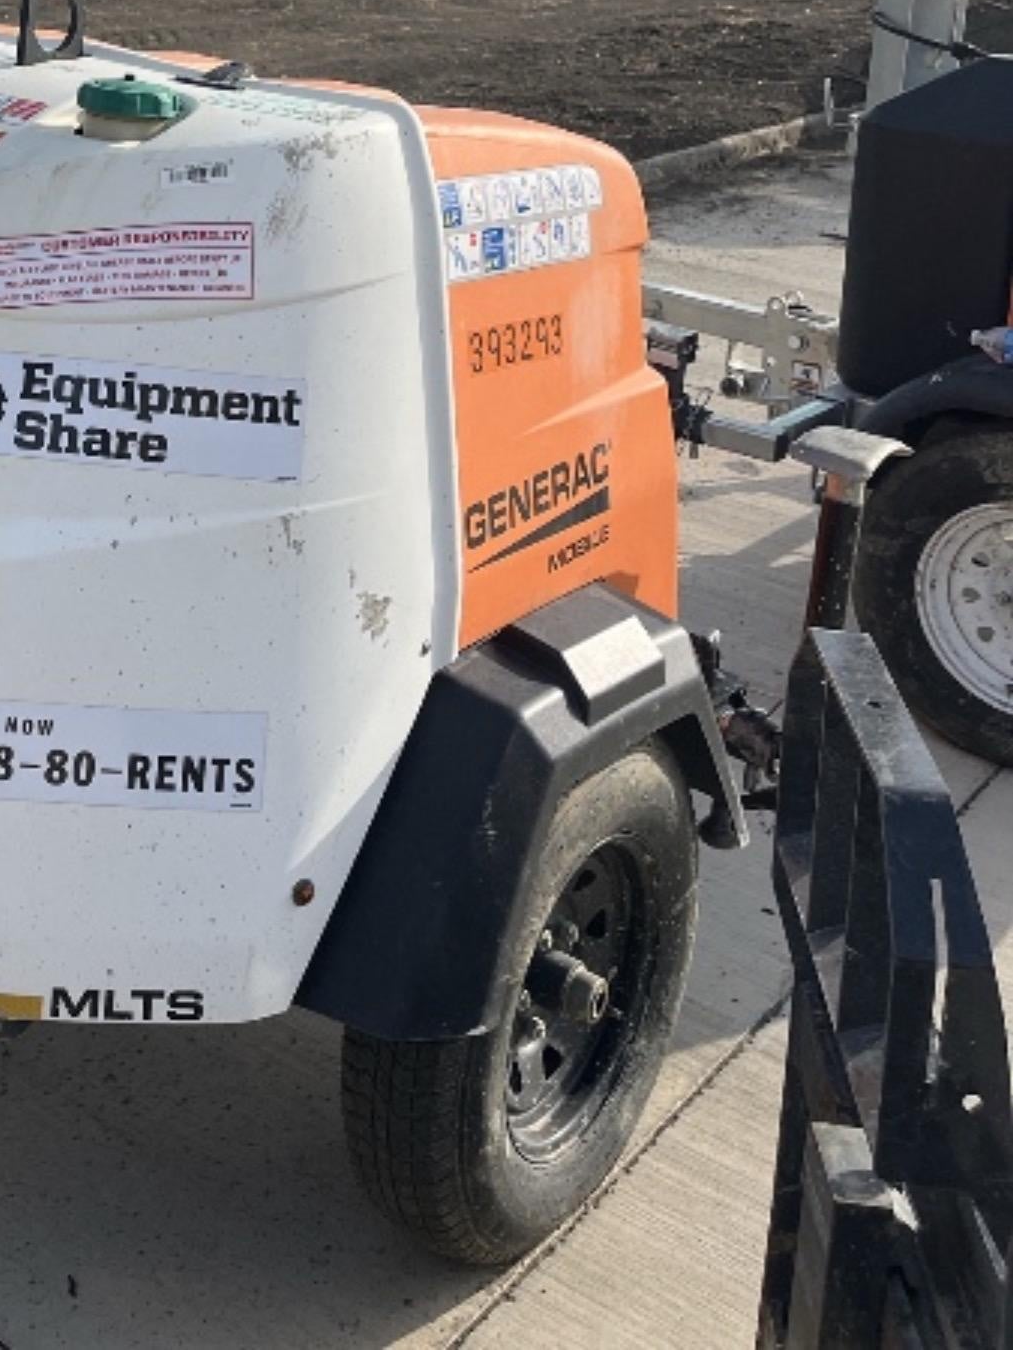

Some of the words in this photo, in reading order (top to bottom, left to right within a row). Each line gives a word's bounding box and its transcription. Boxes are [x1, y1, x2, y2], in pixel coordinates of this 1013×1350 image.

[469, 314, 563, 373] 393293
[19, 362, 302, 426] Equipment
[13, 410, 168, 462] Share
[465, 442, 610, 550] GENERAC
[547, 524, 610, 574] MOBILE
[4, 716, 55, 737] NOW
[50, 986, 205, 1020] MLTS
